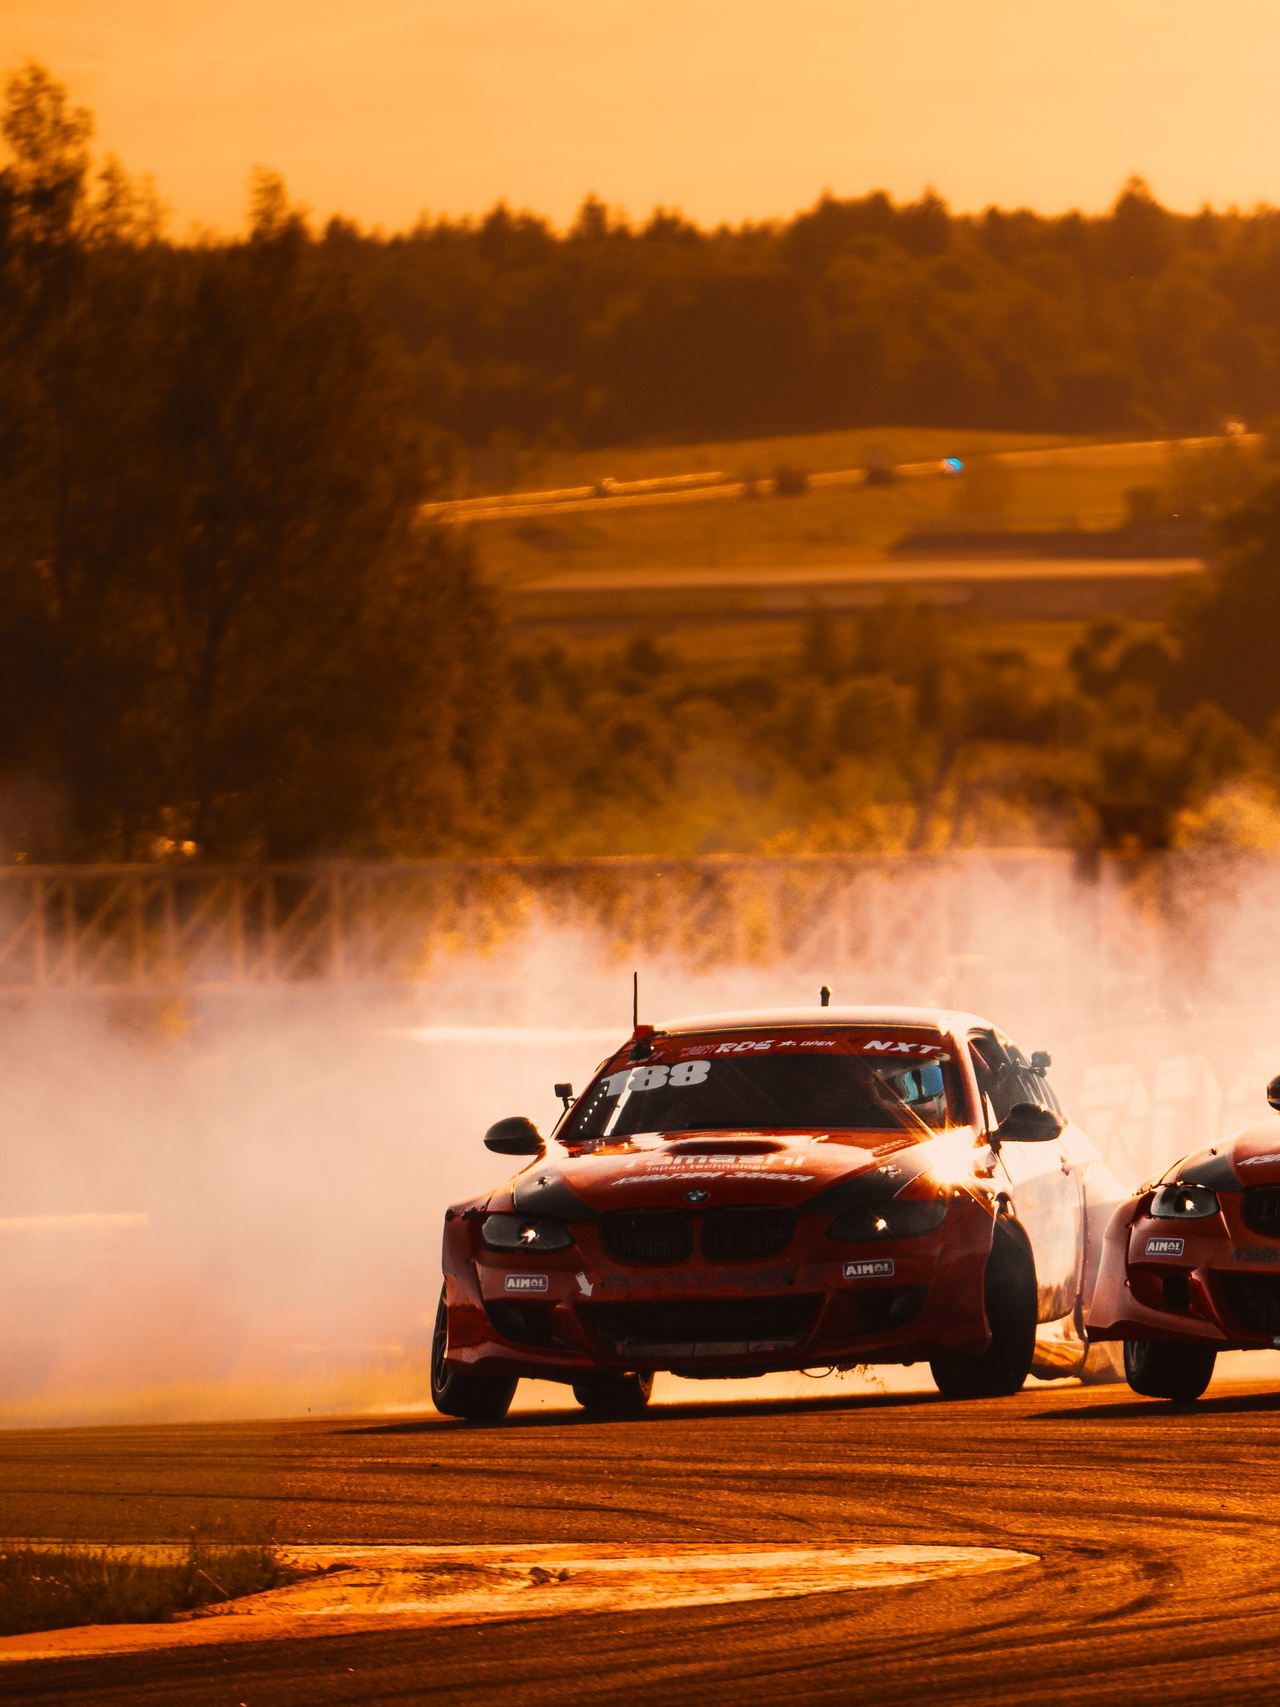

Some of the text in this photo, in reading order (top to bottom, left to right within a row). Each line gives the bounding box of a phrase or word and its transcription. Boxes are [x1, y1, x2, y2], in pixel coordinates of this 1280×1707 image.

[714, 1039, 776, 1054] RDS
[863, 1040, 943, 1054] NXT
[601, 1060, 711, 1097] 188
[690, 1163, 773, 1171] technology
[1148, 1241, 1181, 1251] AIMOL
[846, 1263, 891, 1276] AIMOL
[507, 1278, 546, 1288] AIMOL
